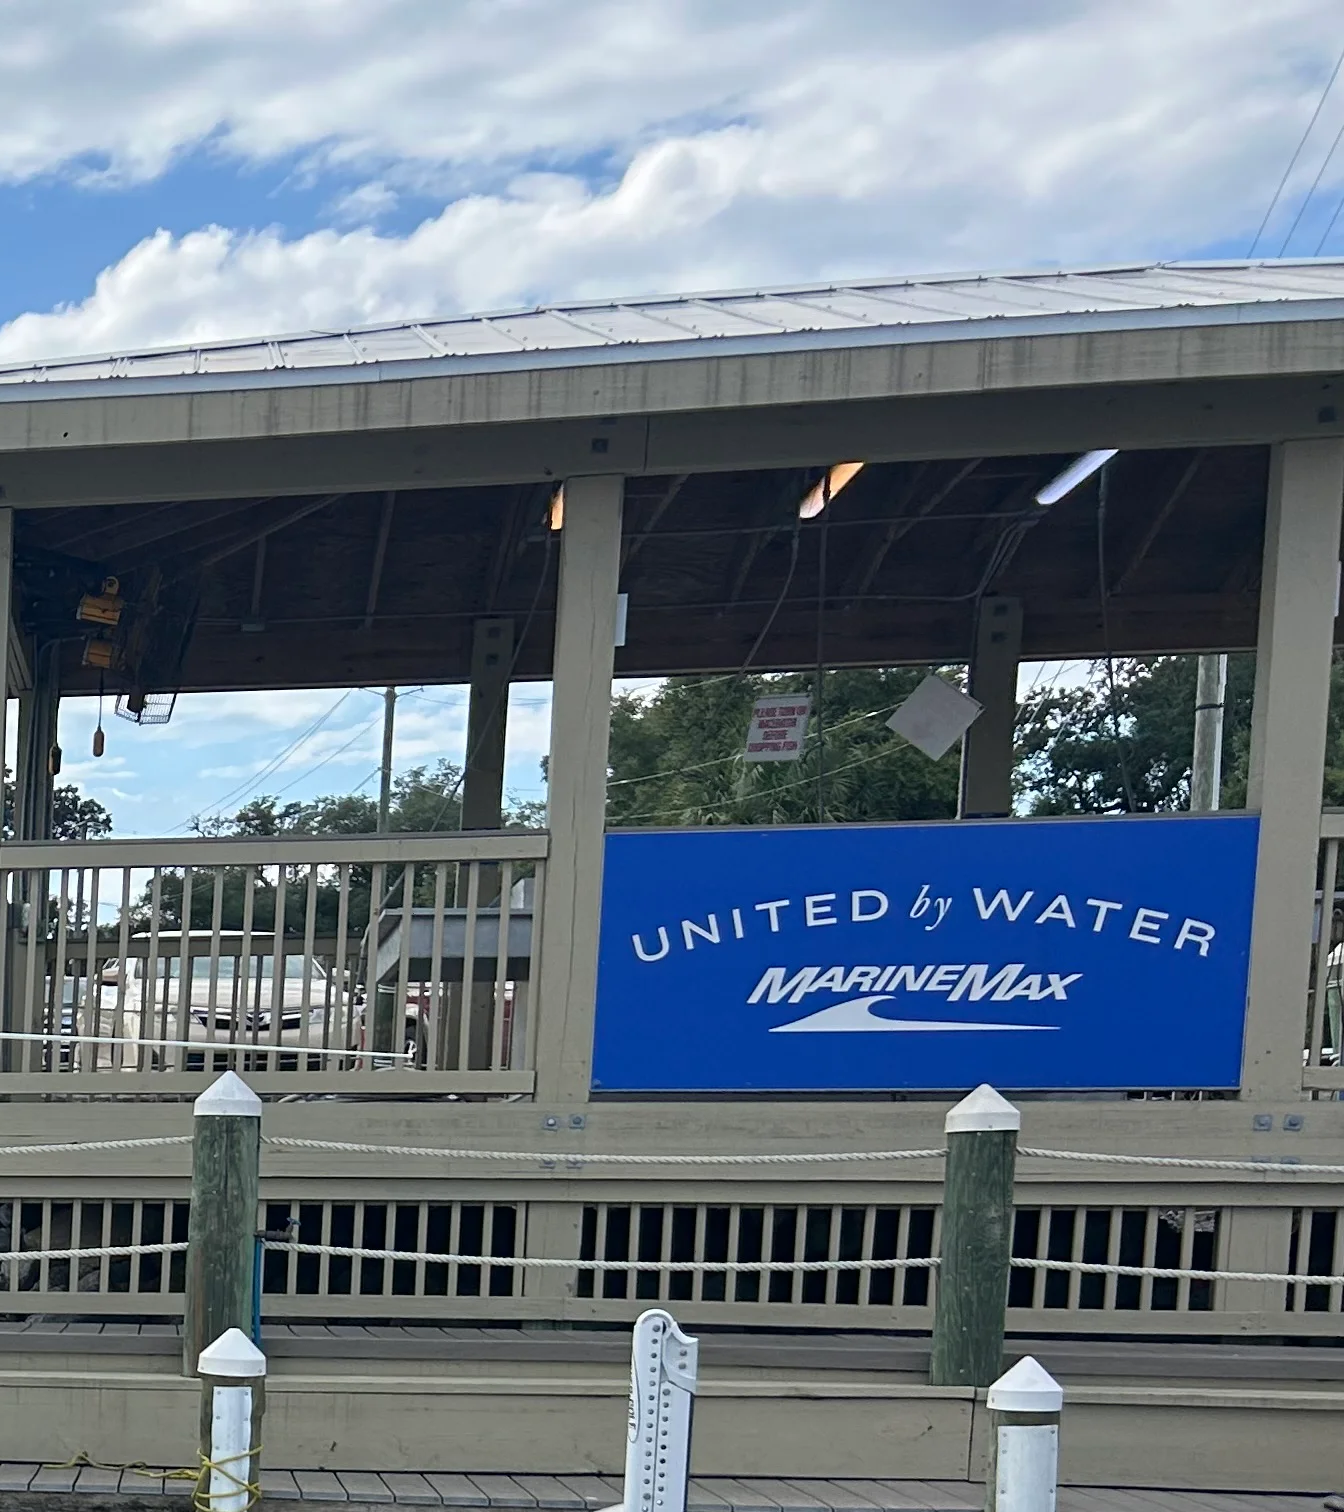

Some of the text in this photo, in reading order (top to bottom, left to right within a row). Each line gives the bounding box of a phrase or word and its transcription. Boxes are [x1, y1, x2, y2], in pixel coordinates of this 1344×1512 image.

[631, 884, 1217, 963] UNITED by WATER
